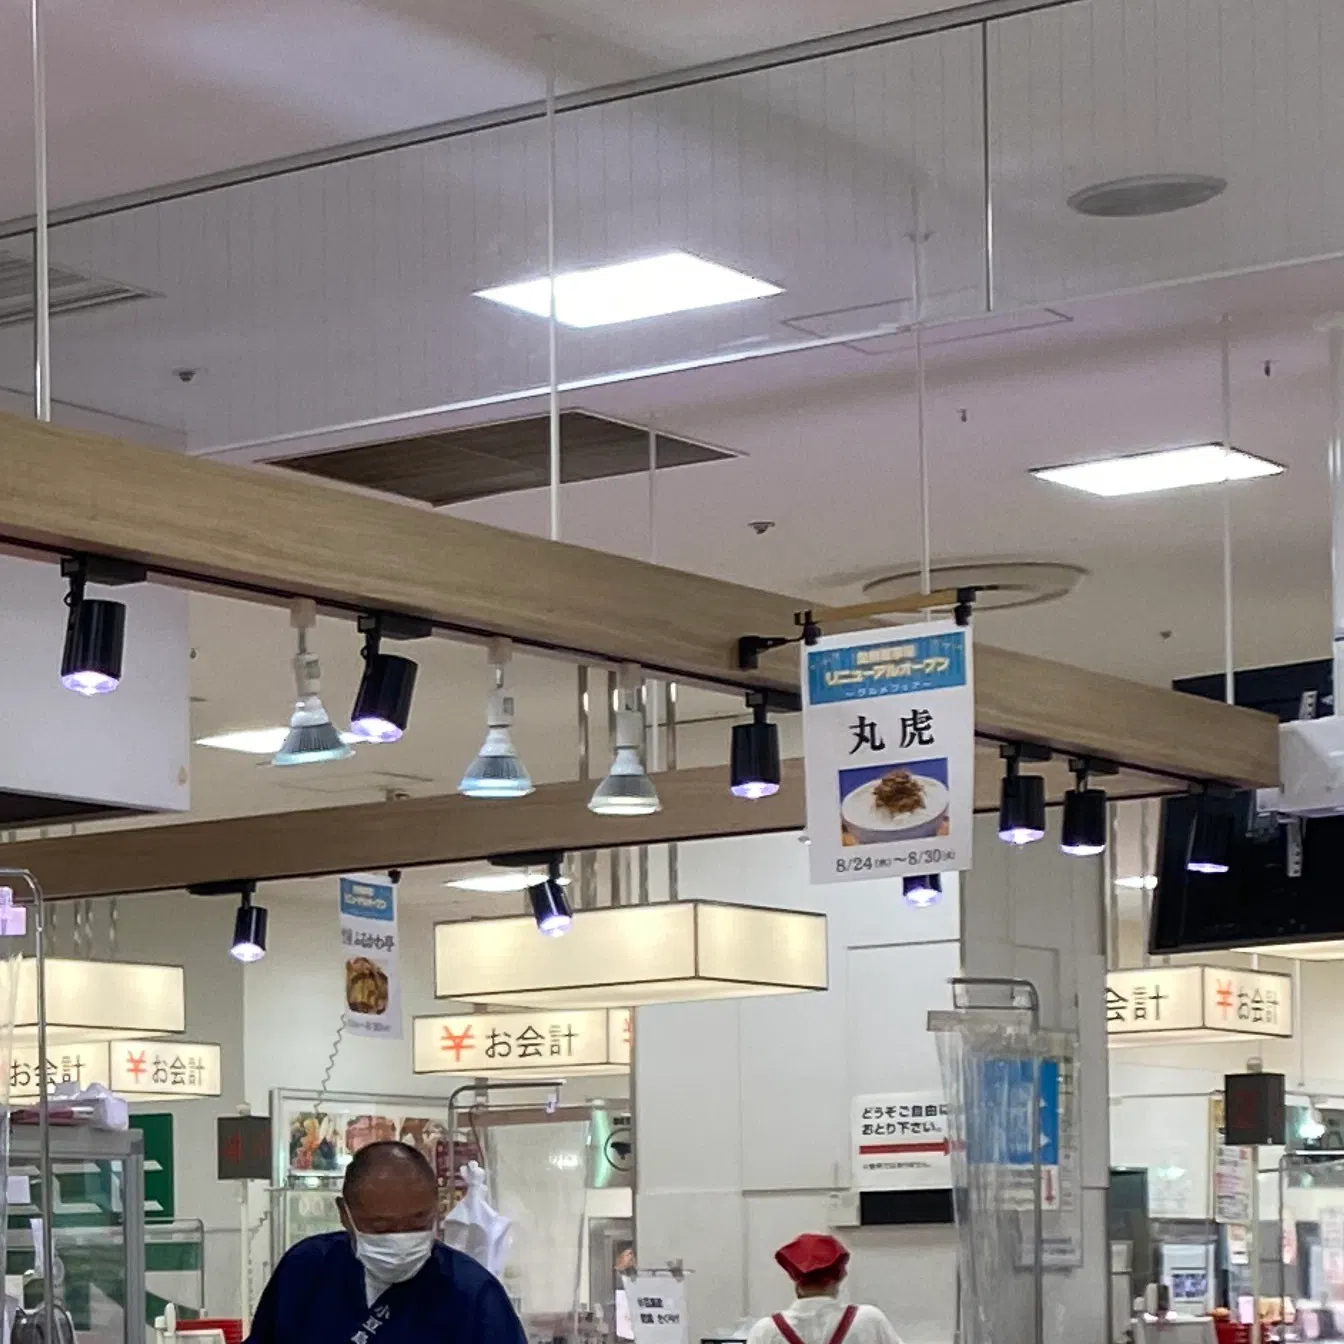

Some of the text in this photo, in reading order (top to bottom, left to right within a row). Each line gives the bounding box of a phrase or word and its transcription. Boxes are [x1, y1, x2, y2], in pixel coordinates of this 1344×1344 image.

[849, 709, 935, 754] 丸虎
[485, 1023, 580, 1059] お会計
[151, 1054, 205, 1086] お会計
